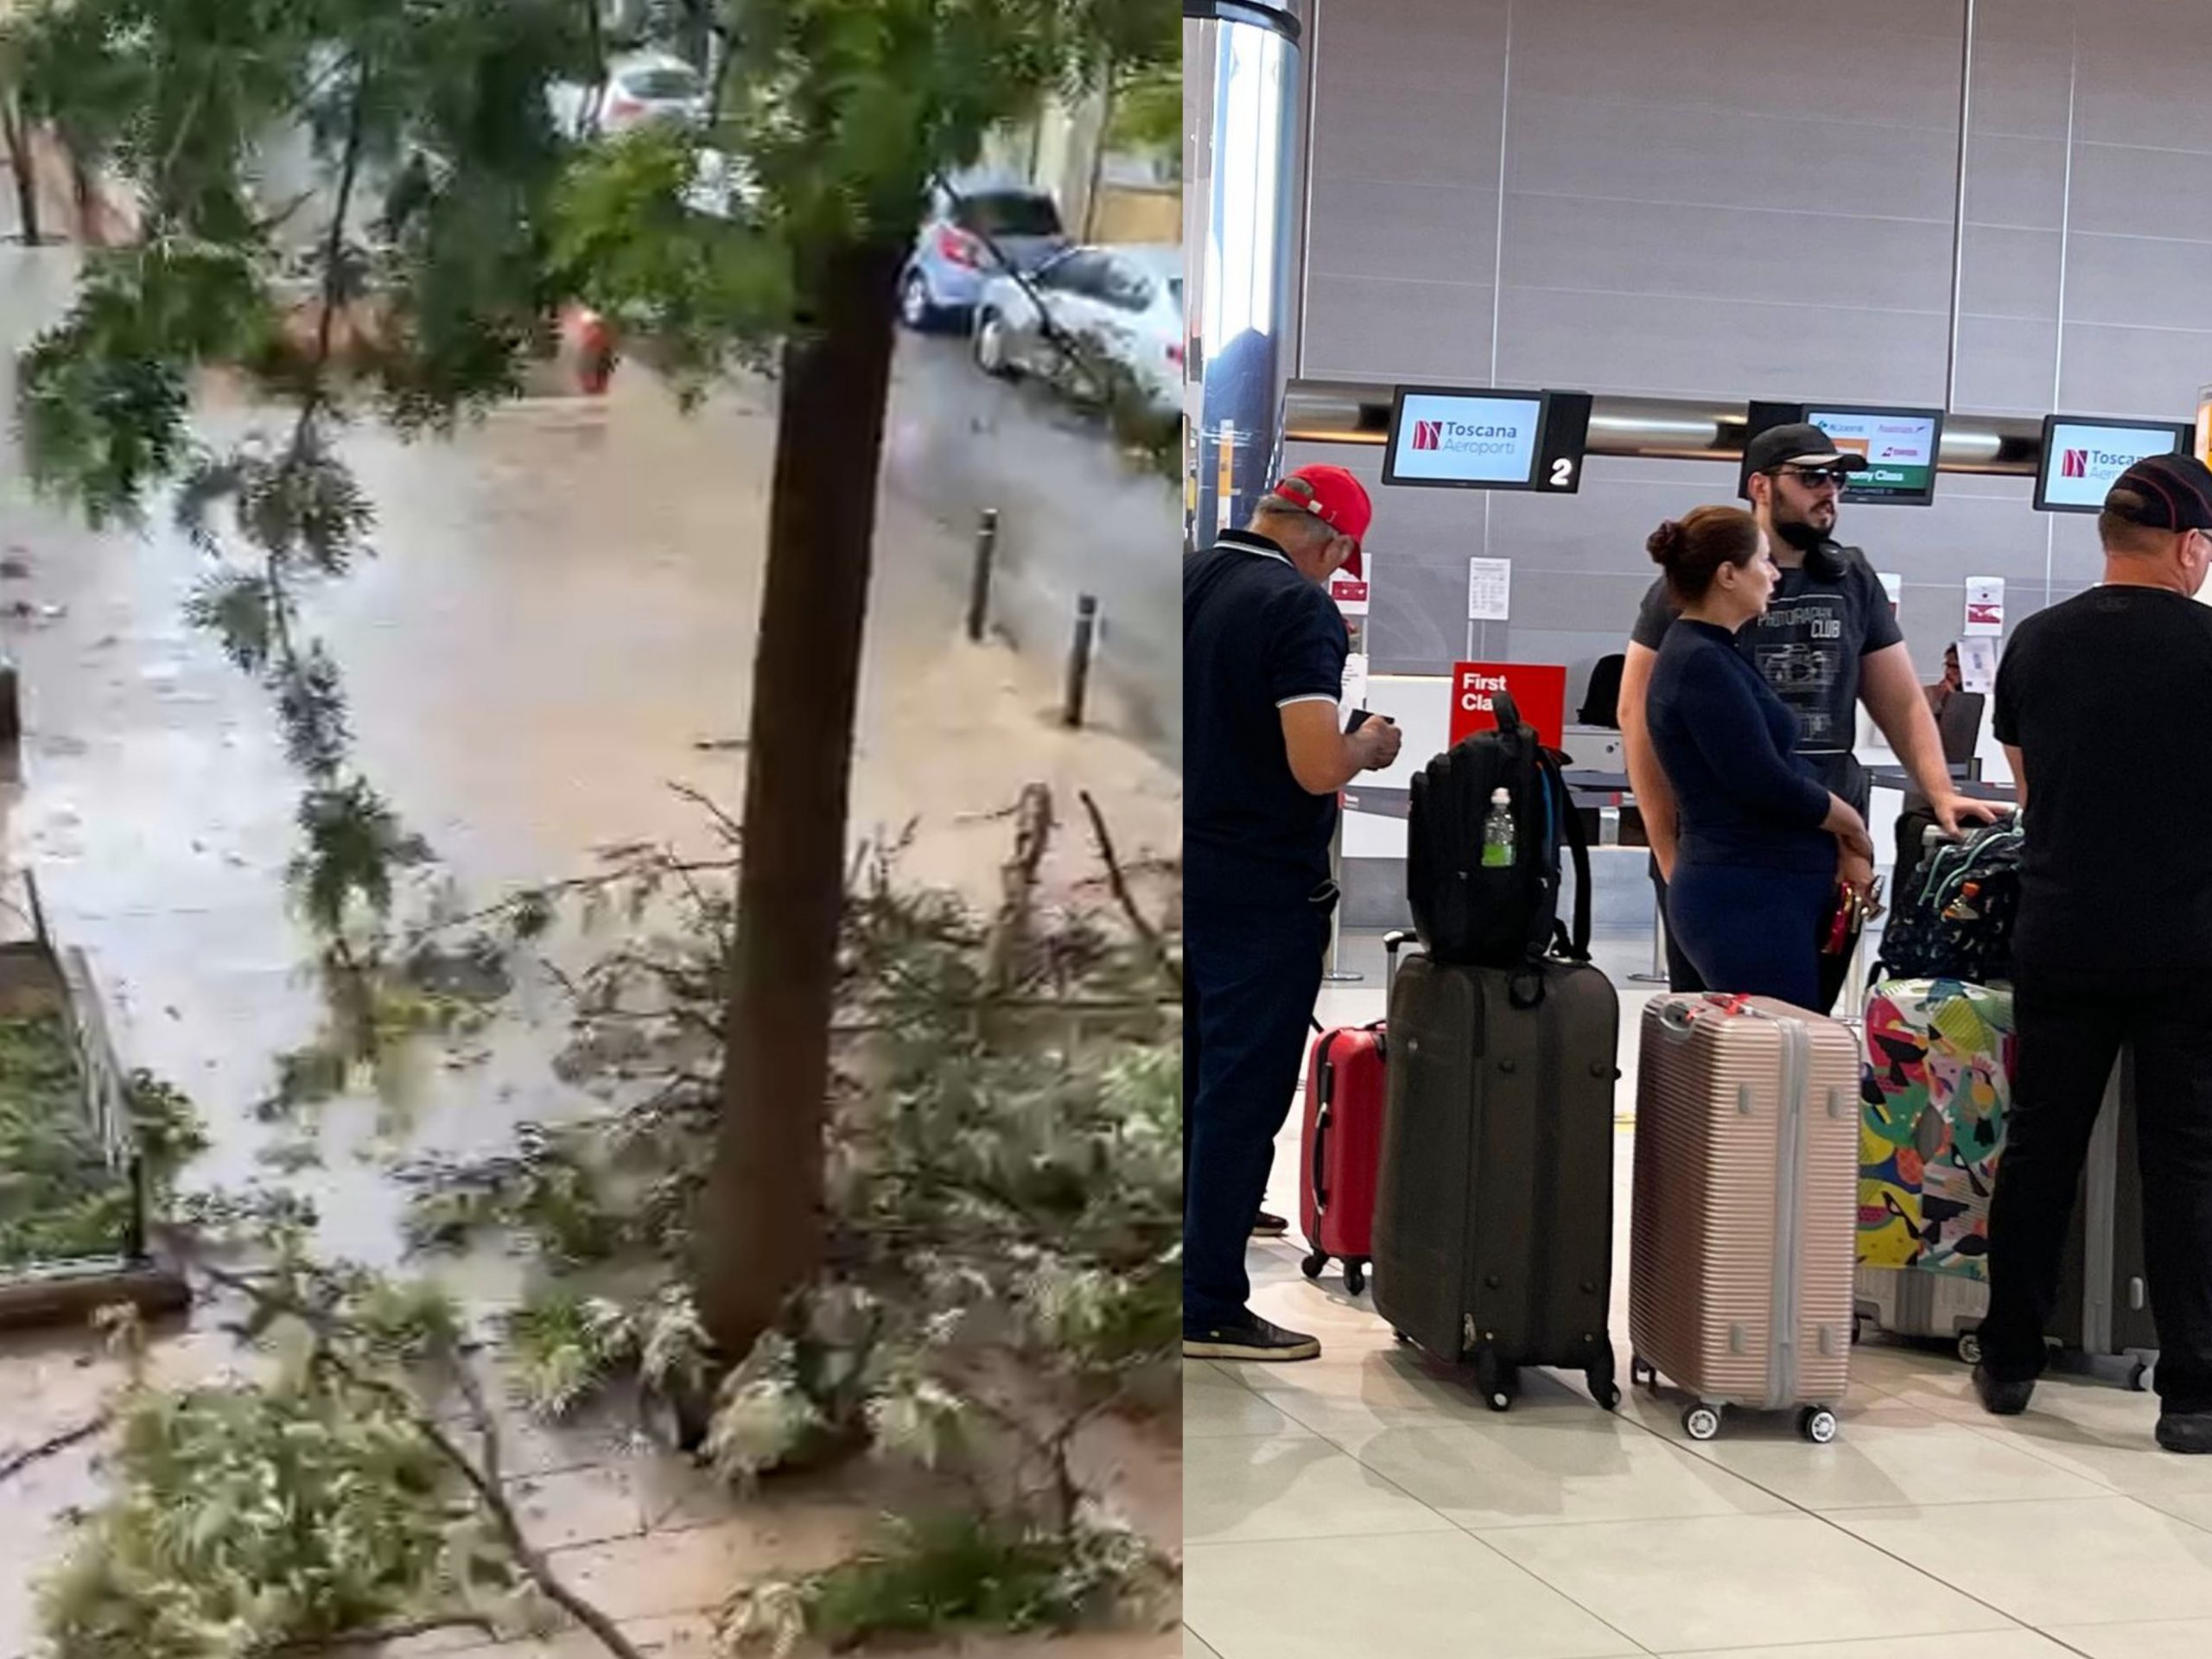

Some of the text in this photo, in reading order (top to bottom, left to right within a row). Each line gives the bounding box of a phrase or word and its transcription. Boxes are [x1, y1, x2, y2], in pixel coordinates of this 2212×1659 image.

[1446, 421, 1517, 439] Toscana
[1441, 438, 1516, 456] Aeroporti
[2091, 450, 2144, 466] Tosca
[1548, 457, 1573, 486] 2
[1810, 620, 1841, 639] CLUB
[1463, 672, 1507, 691] First
[1461, 693, 1493, 712] Cla
